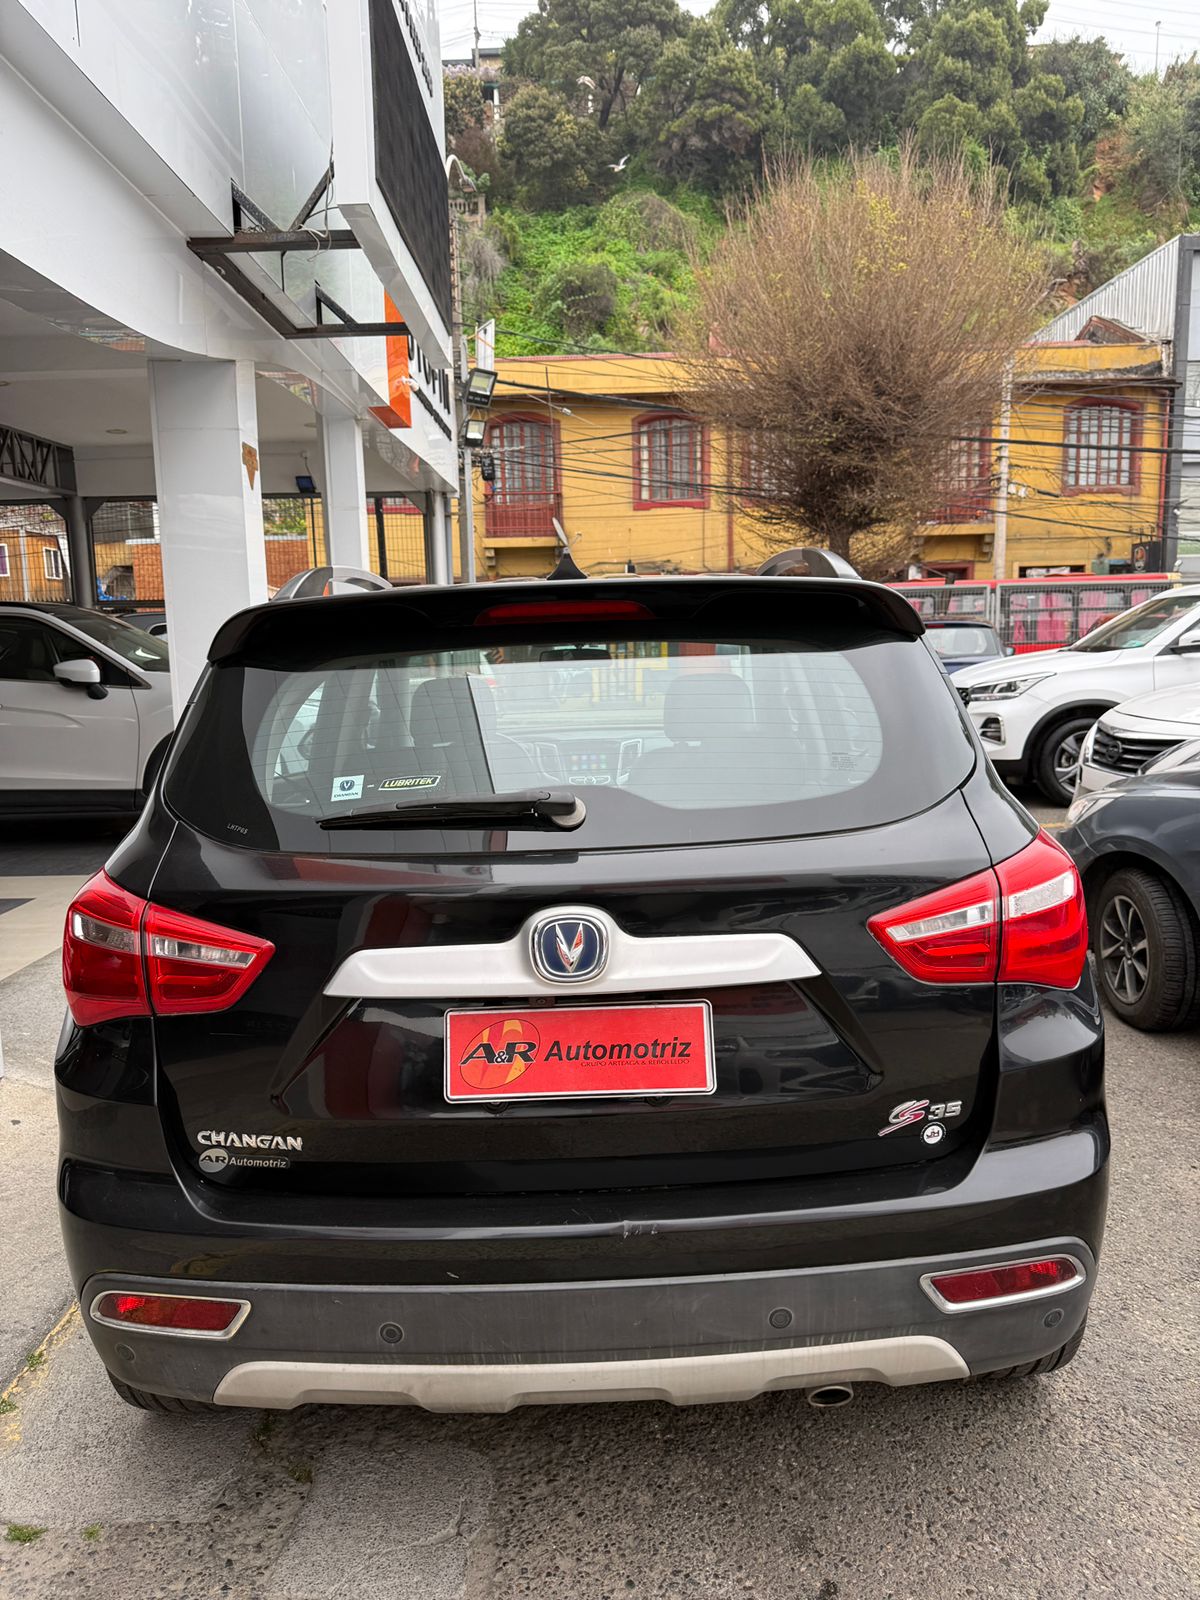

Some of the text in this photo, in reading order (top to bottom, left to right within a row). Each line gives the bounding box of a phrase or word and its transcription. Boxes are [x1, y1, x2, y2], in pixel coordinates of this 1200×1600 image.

[384, 777, 434, 788] LUBRITEK
[459, 1037, 692, 1066] A&R Automotriz
[608, 1059, 639, 1067] ARTEAGA
[197, 1130, 303, 1151] CHANGAN
[229, 1156, 288, 1169] Automotriz
